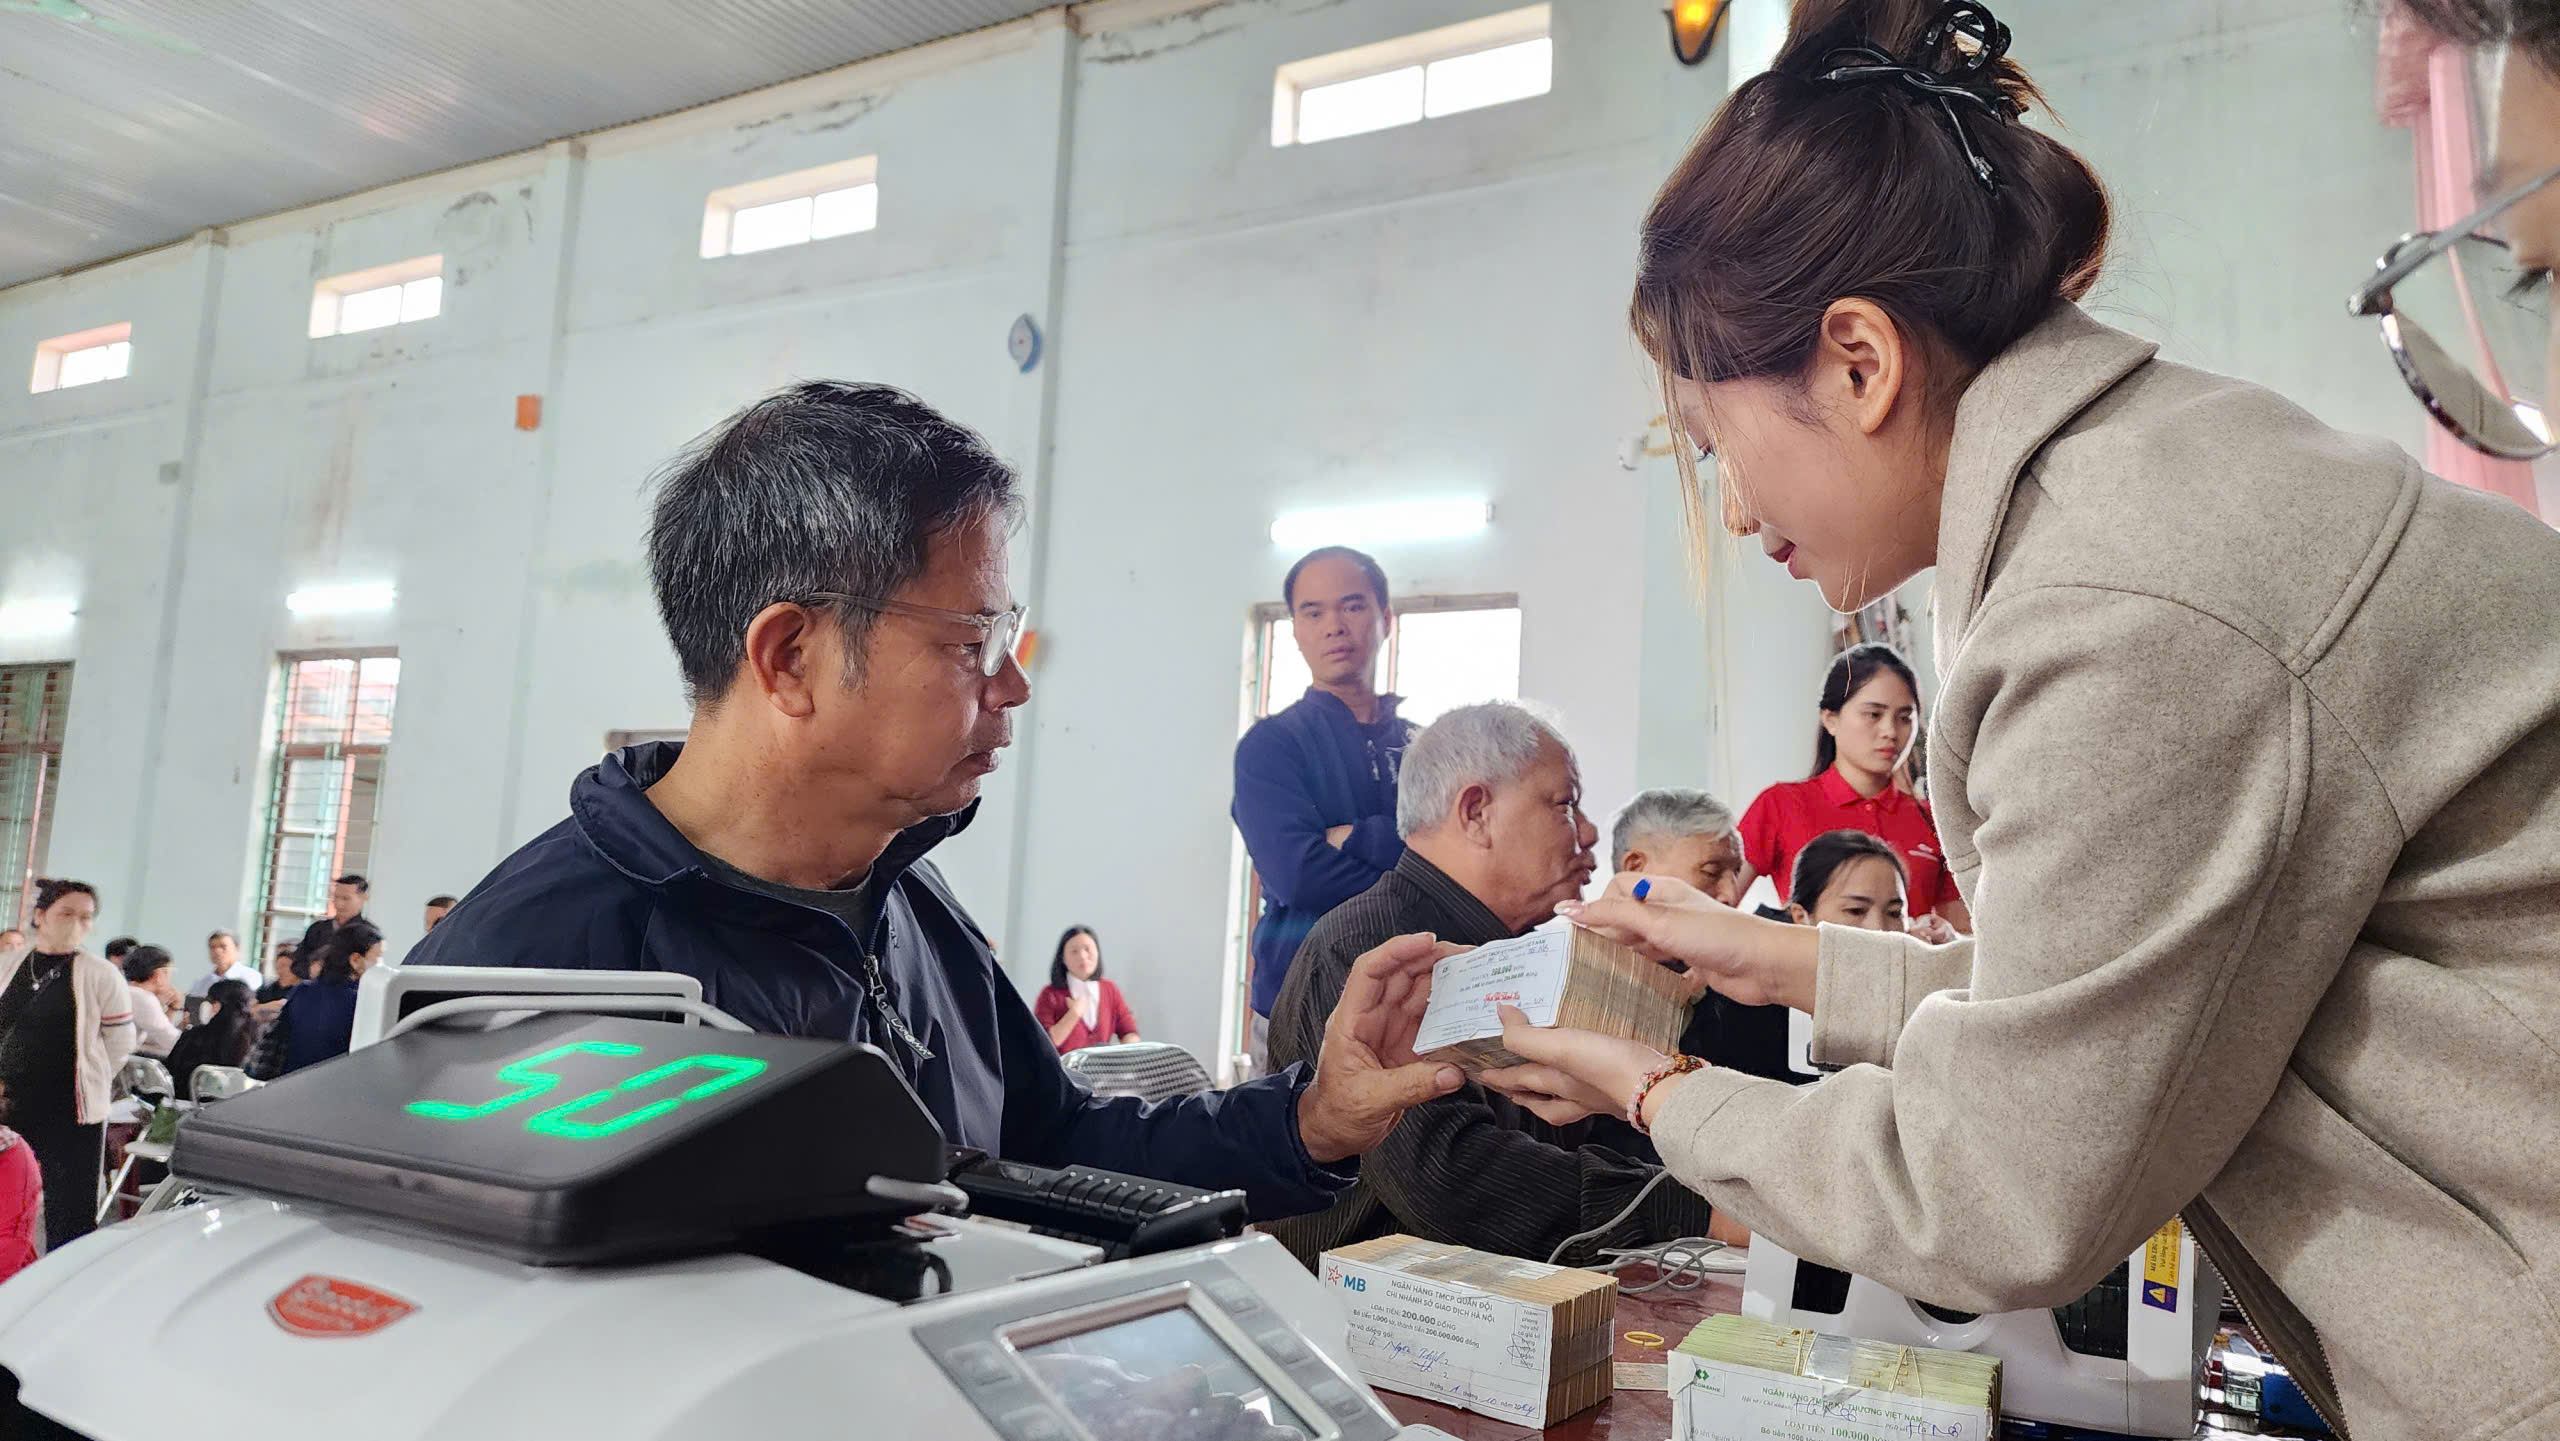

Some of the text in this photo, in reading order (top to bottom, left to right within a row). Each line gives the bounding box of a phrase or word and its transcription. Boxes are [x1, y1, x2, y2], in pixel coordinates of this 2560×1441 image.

[404, 1041, 767, 1140] 50
[1343, 1274, 1367, 1292] MB
[1391, 1279, 1411, 1291] NGÂN
[1412, 1285, 1434, 1297] HÀNG
[1435, 1291, 1455, 1302] TMCP
[1479, 1301, 1493, 1311] ĐỘI
[1385, 1290, 1398, 1299] CHI
[1398, 1293, 1422, 1305] NHÁNH
[1434, 1302, 1452, 1312] GIAO
[1452, 1306, 1470, 1317] DỊCH
[1470, 1311, 1481, 1320] HÀ
[1481, 1314, 1495, 1323] NỘI
[1401, 1309, 1436, 1325] 200.000
[1372, 1313, 1388, 1324] 1.000
[1425, 1327, 1465, 1343] 200.000.000
[1762, 1387, 1785, 1398] NGÂN
[1786, 1391, 1809, 1403] HÀNG
[1847, 1403, 1883, 1416] THƯƠNG
[1884, 1410, 1902, 1420] VIỆT
[1903, 1413, 1923, 1424] NAM
[1831, 1426, 1870, 1441] 100.000
